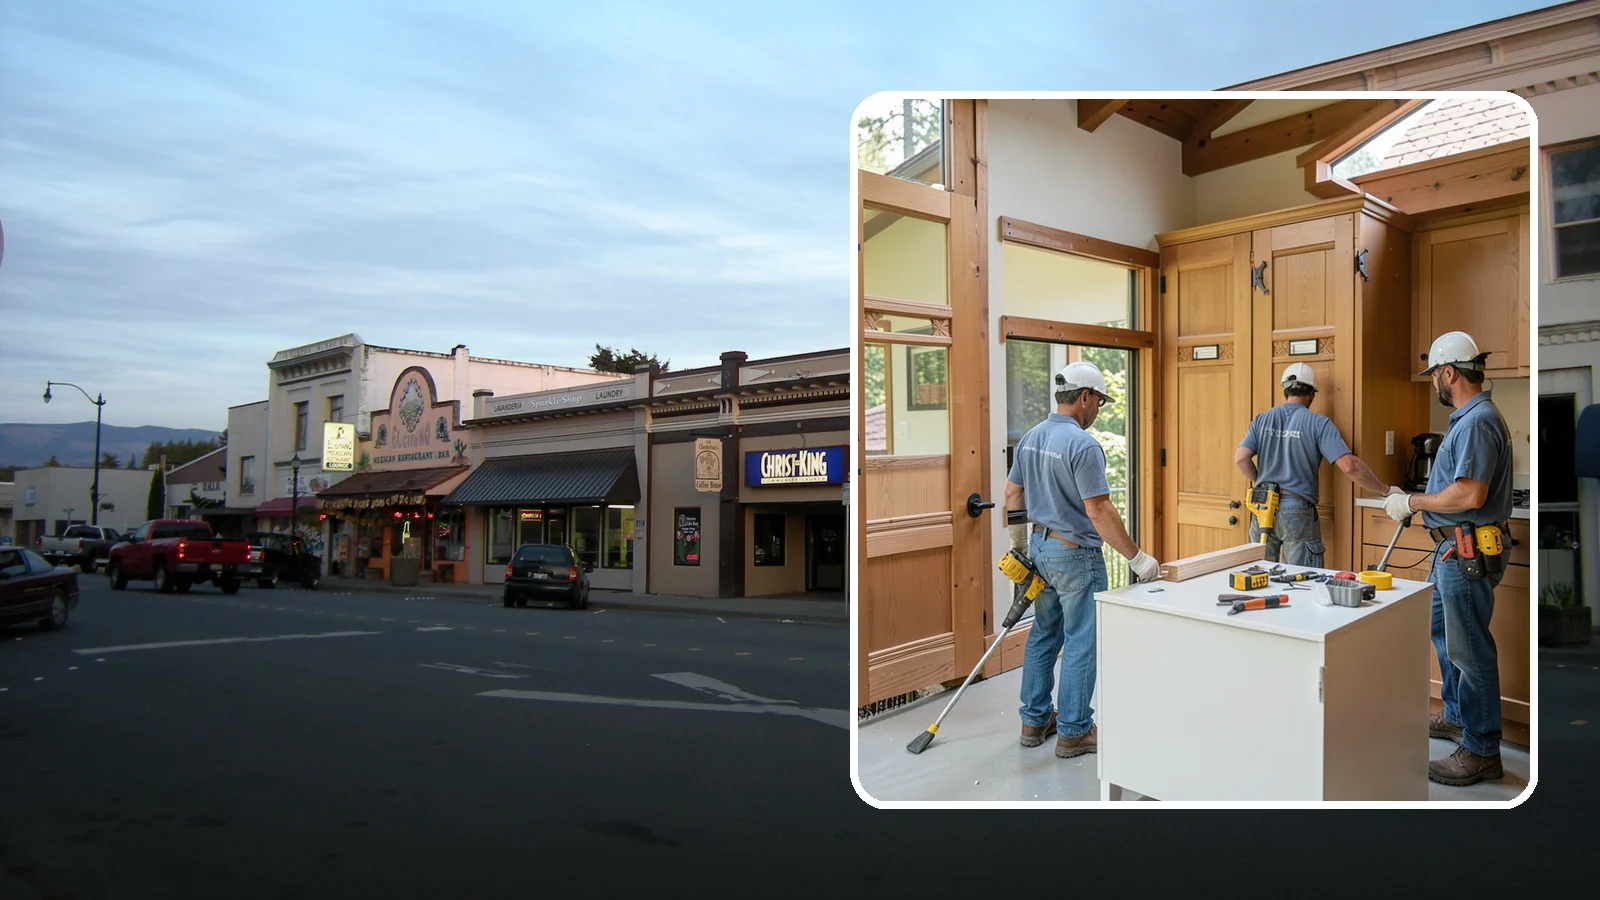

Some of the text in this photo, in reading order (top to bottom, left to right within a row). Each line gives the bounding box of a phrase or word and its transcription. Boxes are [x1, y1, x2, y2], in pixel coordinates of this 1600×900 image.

[596, 389, 623, 400] LAUNDRY
[493, 402, 522, 412] LAVANDERIA
[531, 395, 582, 408] Sparkle Shop
[397, 451, 433, 463] RESTAURANT
[438, 450, 450, 459] BAR
[761, 450, 827, 477] CHRIST KING
